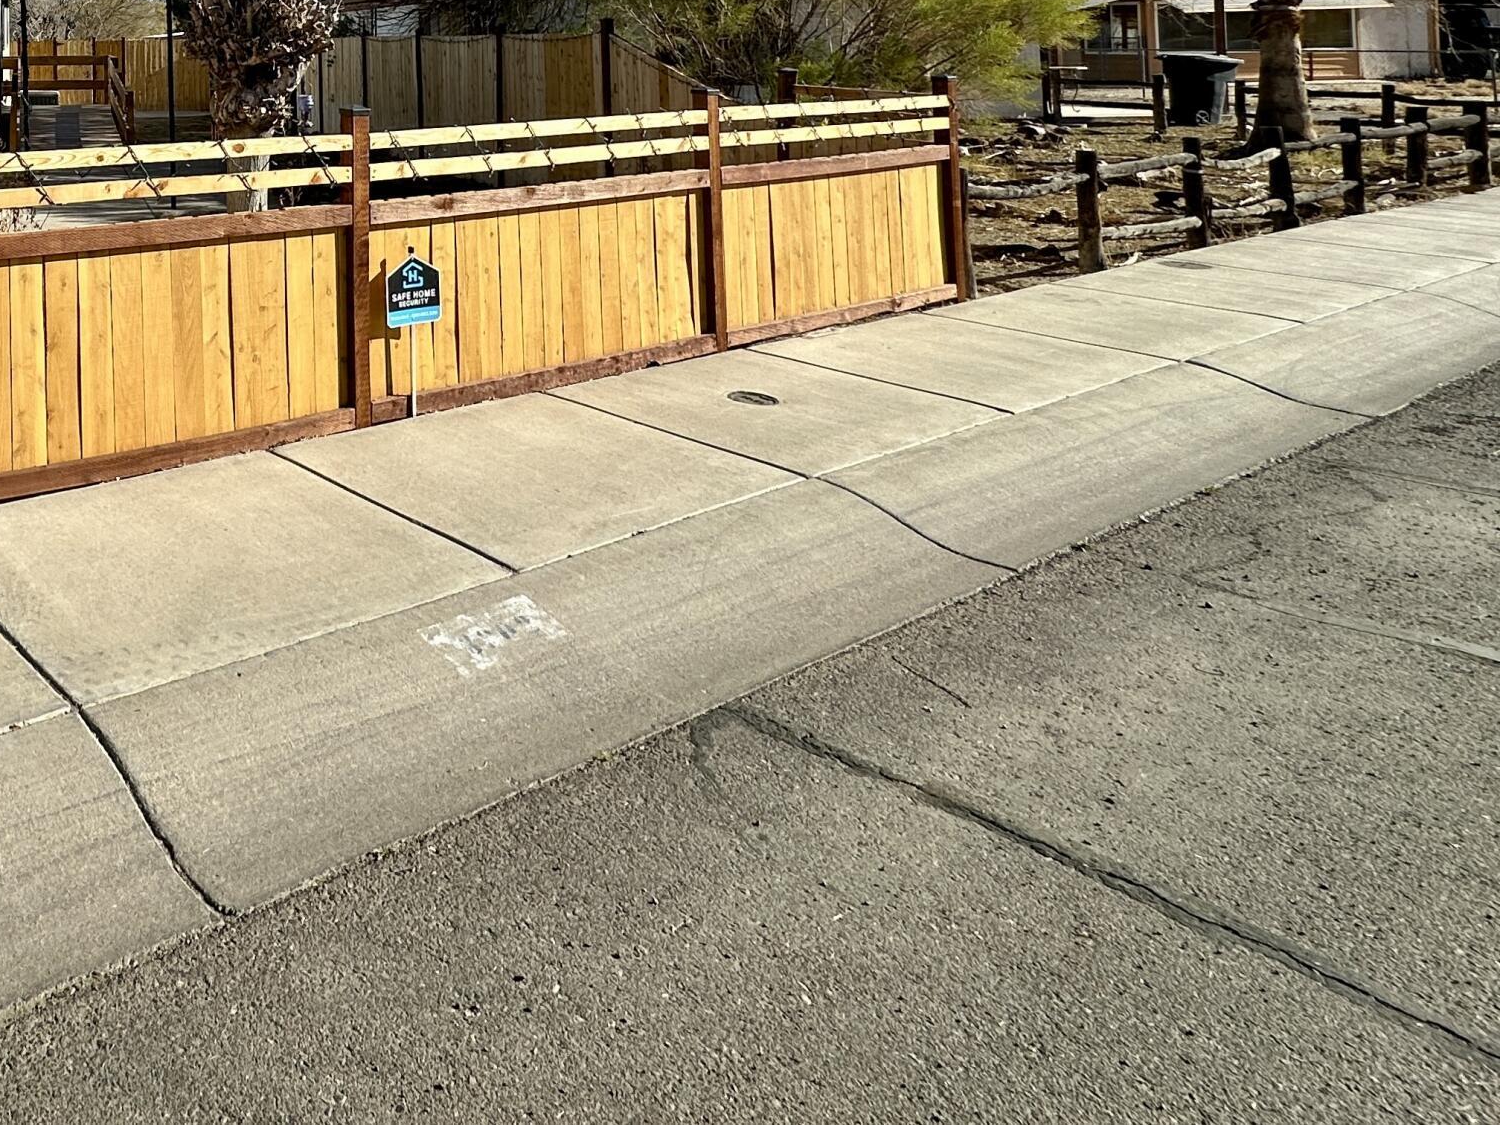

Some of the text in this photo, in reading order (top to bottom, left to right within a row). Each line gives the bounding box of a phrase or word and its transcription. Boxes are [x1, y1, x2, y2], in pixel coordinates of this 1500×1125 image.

[391, 288, 436, 302] SAFE HOME
[398, 298, 429, 308] SECURITY
